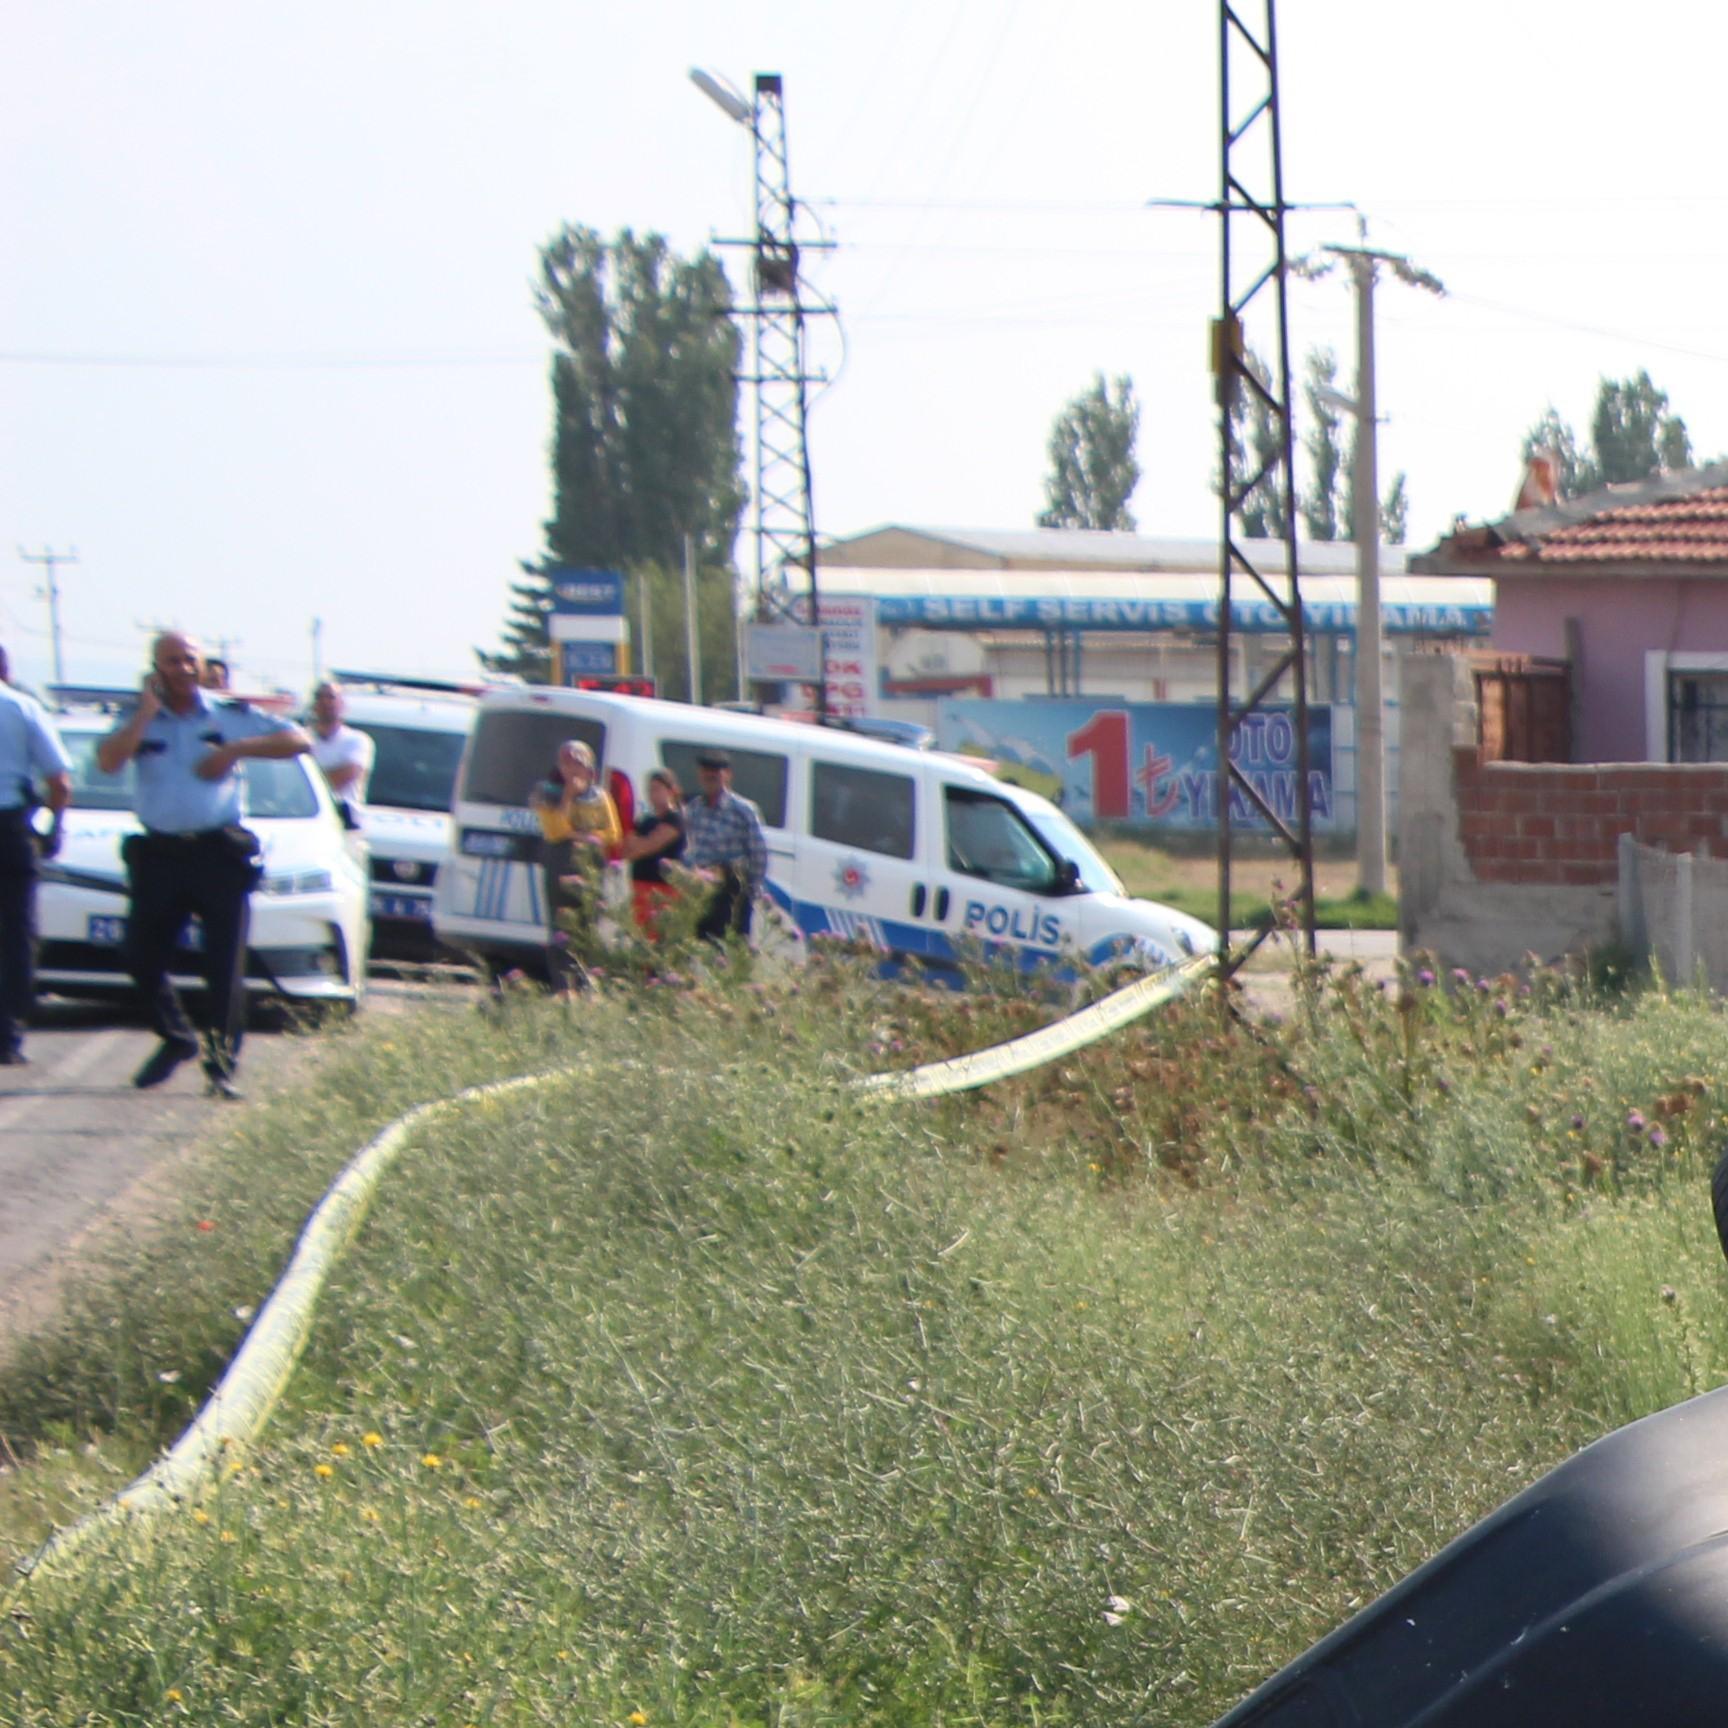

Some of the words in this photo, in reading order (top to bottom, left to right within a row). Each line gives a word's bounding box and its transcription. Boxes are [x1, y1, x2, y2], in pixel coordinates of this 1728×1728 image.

[924, 600, 1024, 621] SELF
[1307, 603, 1467, 625] YIAMA
[964, 899, 1061, 945] POLİS
